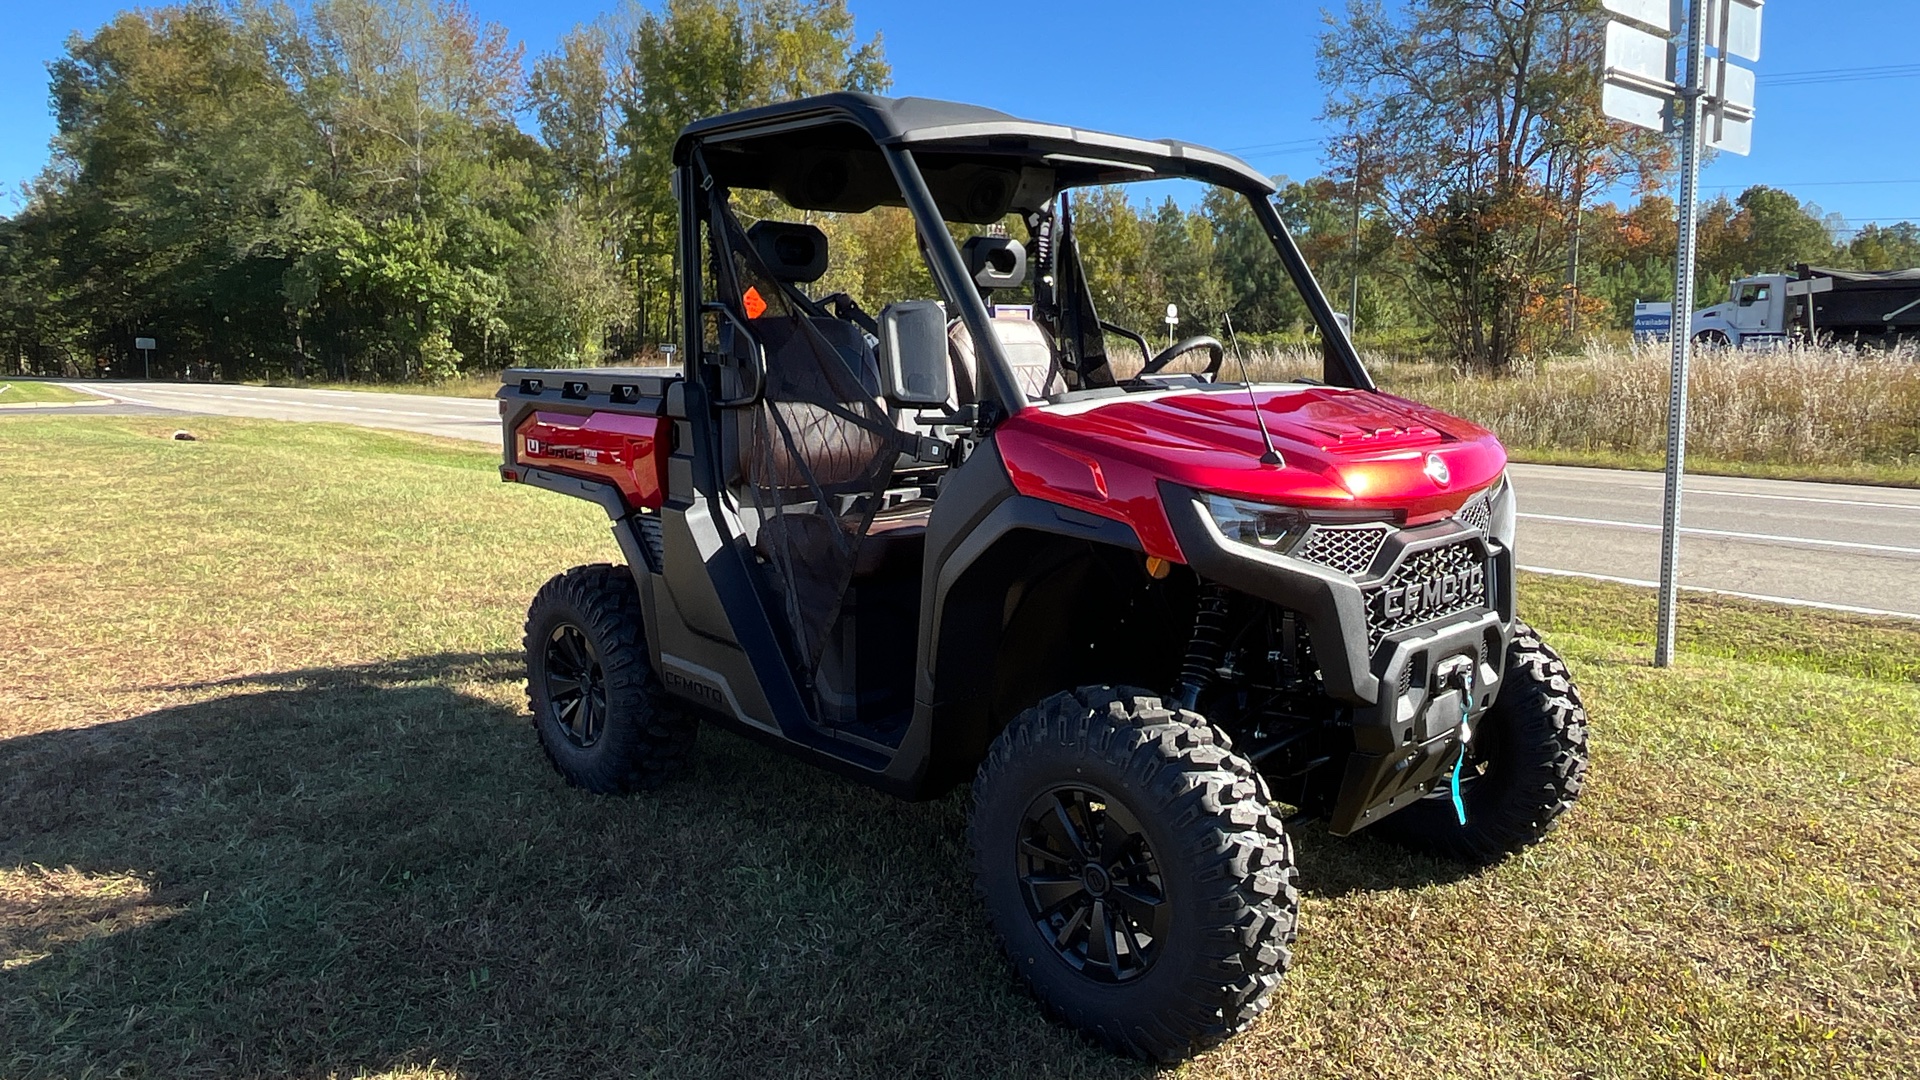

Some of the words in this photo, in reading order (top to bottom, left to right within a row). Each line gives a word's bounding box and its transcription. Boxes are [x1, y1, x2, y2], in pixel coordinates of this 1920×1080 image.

[1634, 318, 1670, 326] Available
[1384, 566, 1483, 618] CFMOTO
[664, 671, 723, 704] CFMOTO
